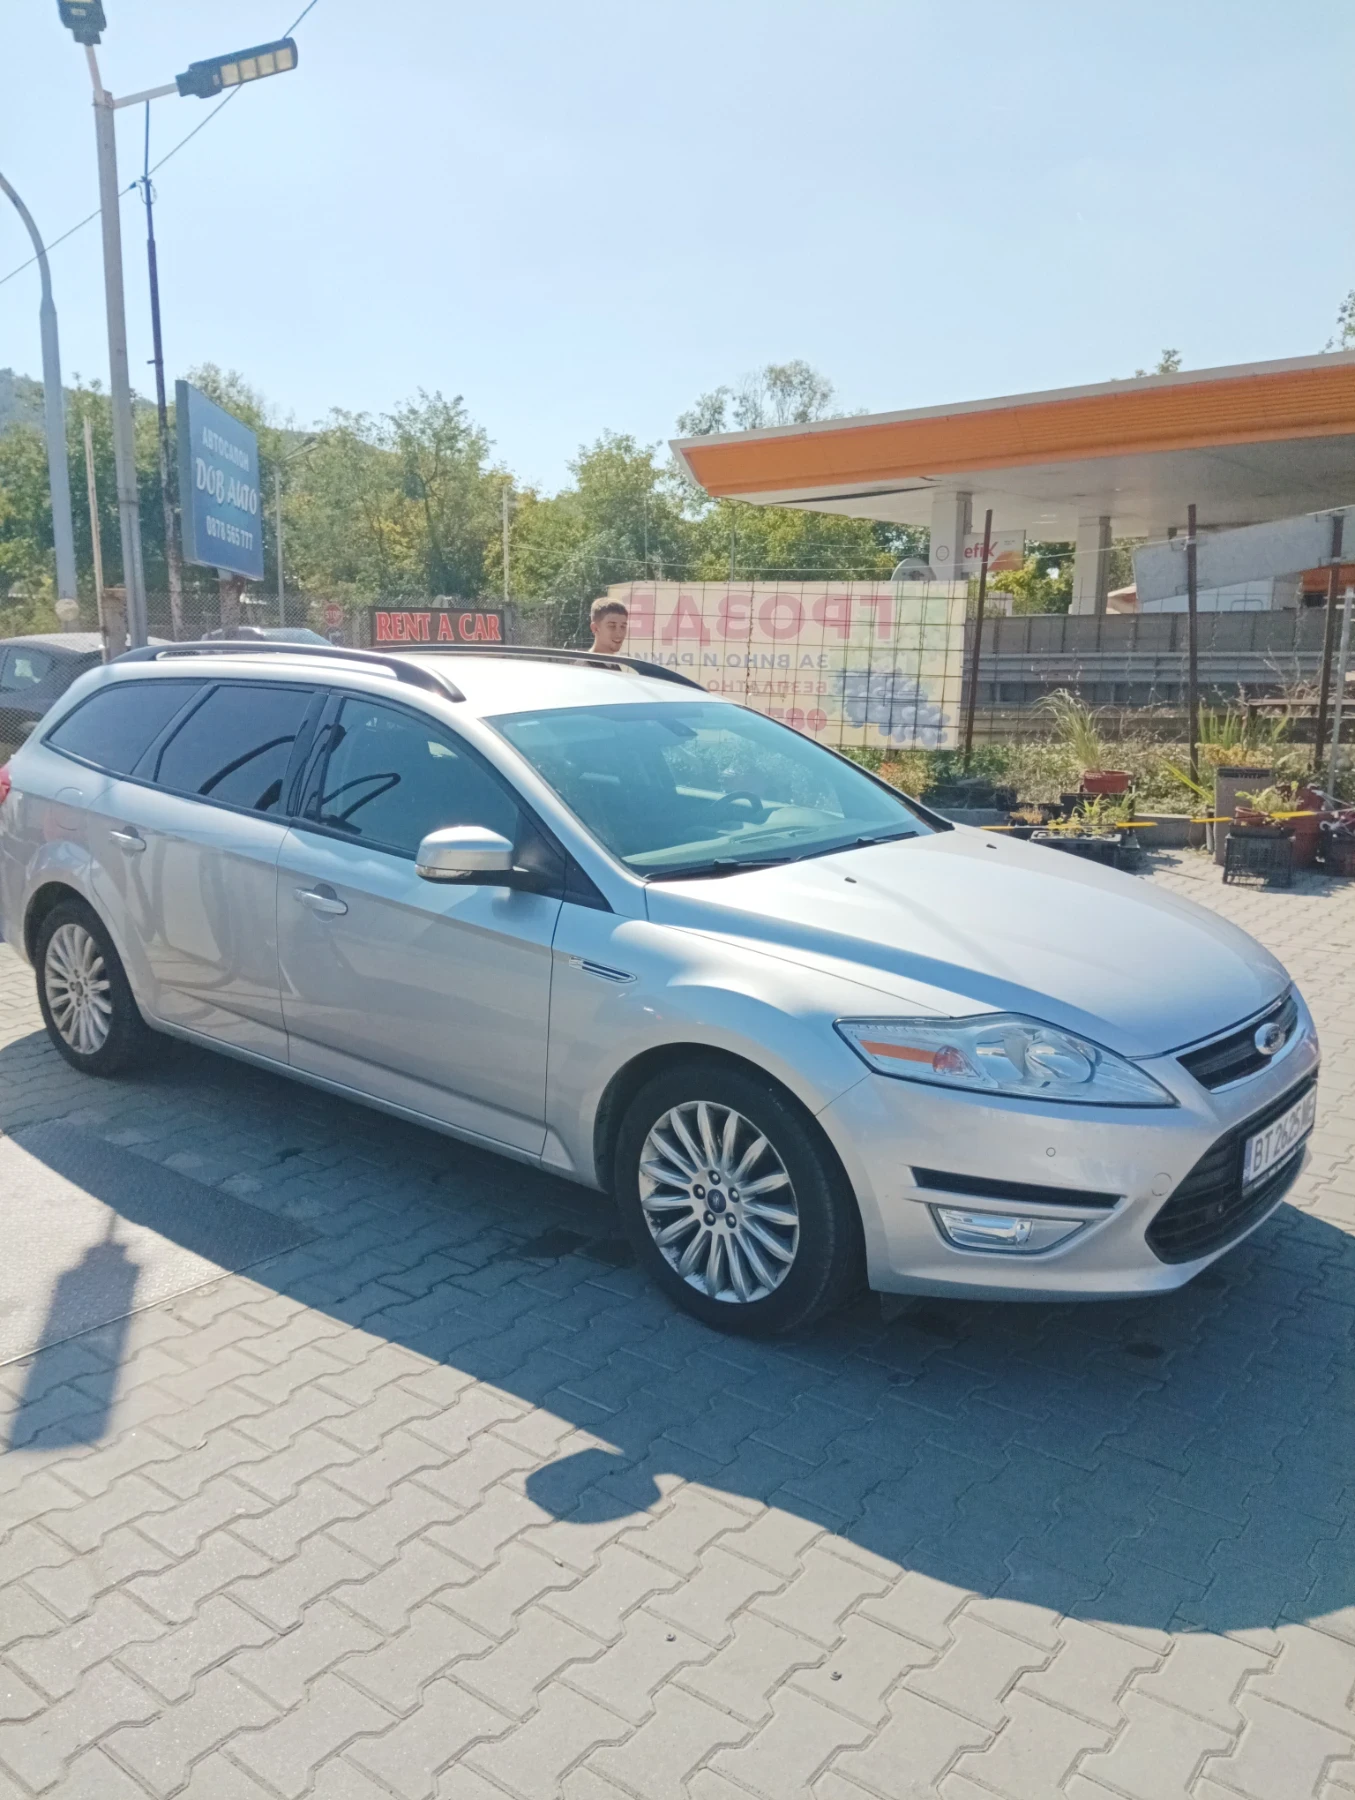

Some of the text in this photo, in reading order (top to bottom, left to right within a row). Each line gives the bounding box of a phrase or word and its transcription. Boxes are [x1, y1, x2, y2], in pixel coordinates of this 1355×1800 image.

[206, 515, 226, 541] 0878
[375, 612, 502, 641] RENT A CAR
[1253, 1130, 1274, 1172] BT
